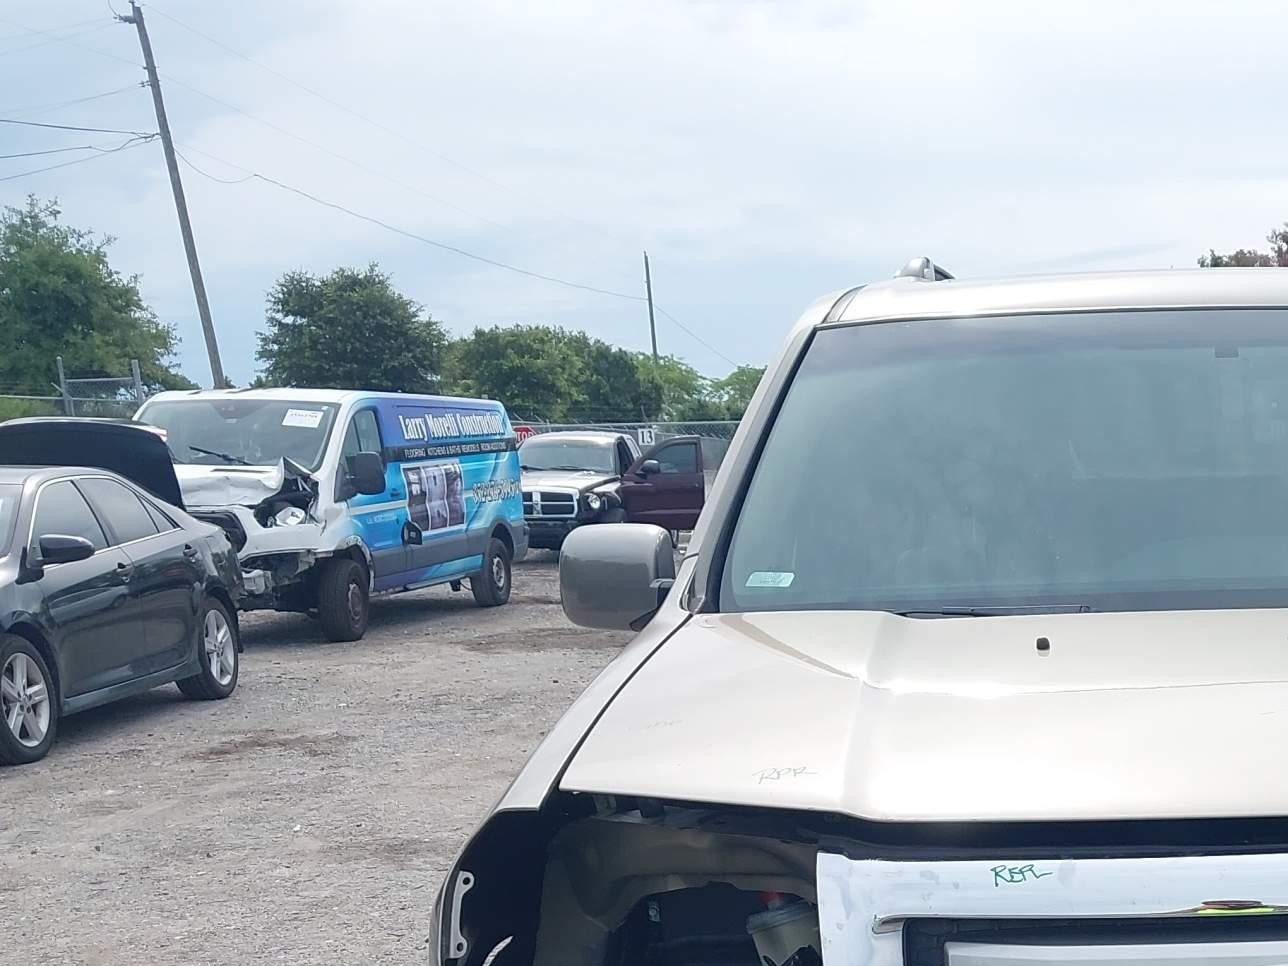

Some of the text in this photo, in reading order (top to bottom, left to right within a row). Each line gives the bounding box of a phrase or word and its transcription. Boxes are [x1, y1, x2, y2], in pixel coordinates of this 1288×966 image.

[398, 412, 504, 441] Larry Morelli Construction
[640, 430, 654, 445] 13
[405, 448, 426, 459] FLOORING
